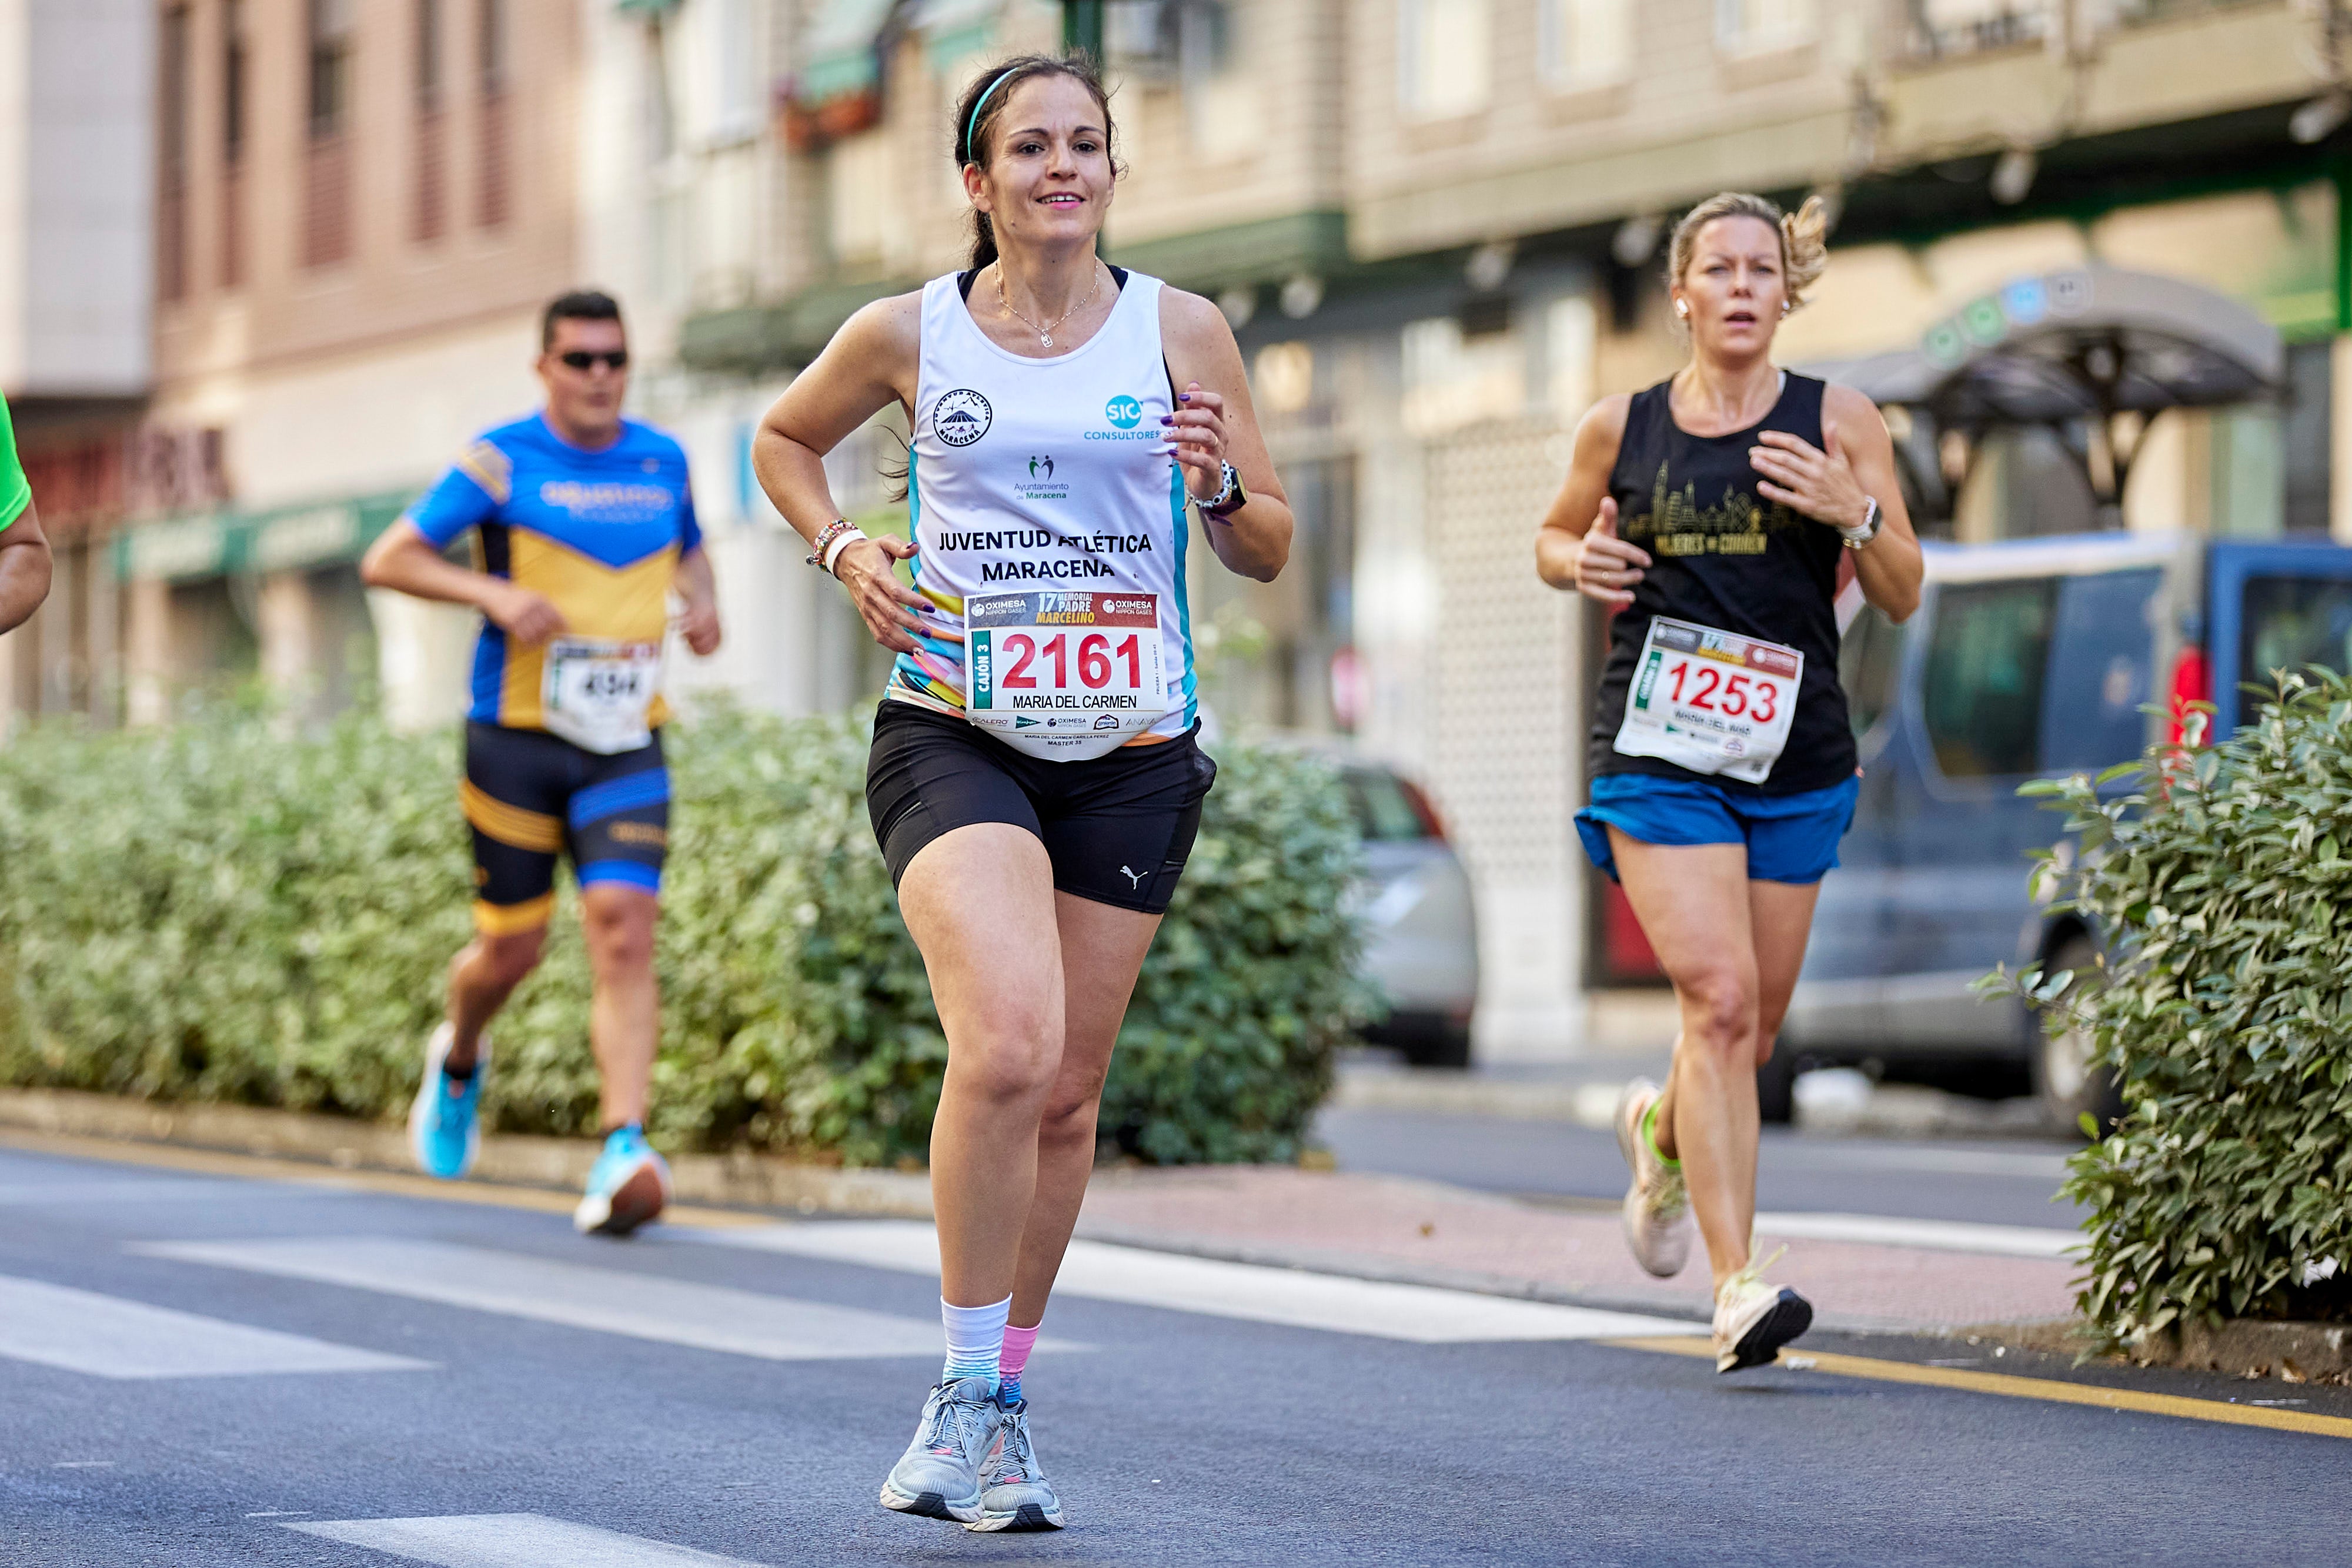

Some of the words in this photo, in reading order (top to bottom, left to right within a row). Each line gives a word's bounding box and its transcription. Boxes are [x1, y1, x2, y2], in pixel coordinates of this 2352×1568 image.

[1107, 403, 1141, 420] SIC
[939, 429, 981, 444] MARACENA
[1084, 430, 1160, 440] CONSULTORES
[1014, 482, 1069, 492] Ayuntamiento
[939, 530, 1051, 551] JUVENTUD
[1058, 530, 1152, 553] ATLÉTICA
[981, 559, 1115, 582] MARACENA
[1038, 593, 1058, 613] 17
[1058, 593, 1093, 601] MEMORIAL
[985, 599, 1026, 610] OXIMESA
[1058, 601, 1091, 613] PADRE
[1115, 600, 1152, 609] OXIMESA
[1035, 611, 1095, 624] MARCELINO
[977, 644, 988, 652] 3
[1001, 633, 1141, 688] 2161
[974, 657, 990, 693] CAJÓN
[1671, 662, 1777, 723] 1253
[1013, 696, 1052, 708] MARIA
[1055, 696, 1080, 708] DEL
[1083, 696, 1137, 708] CARMEN
